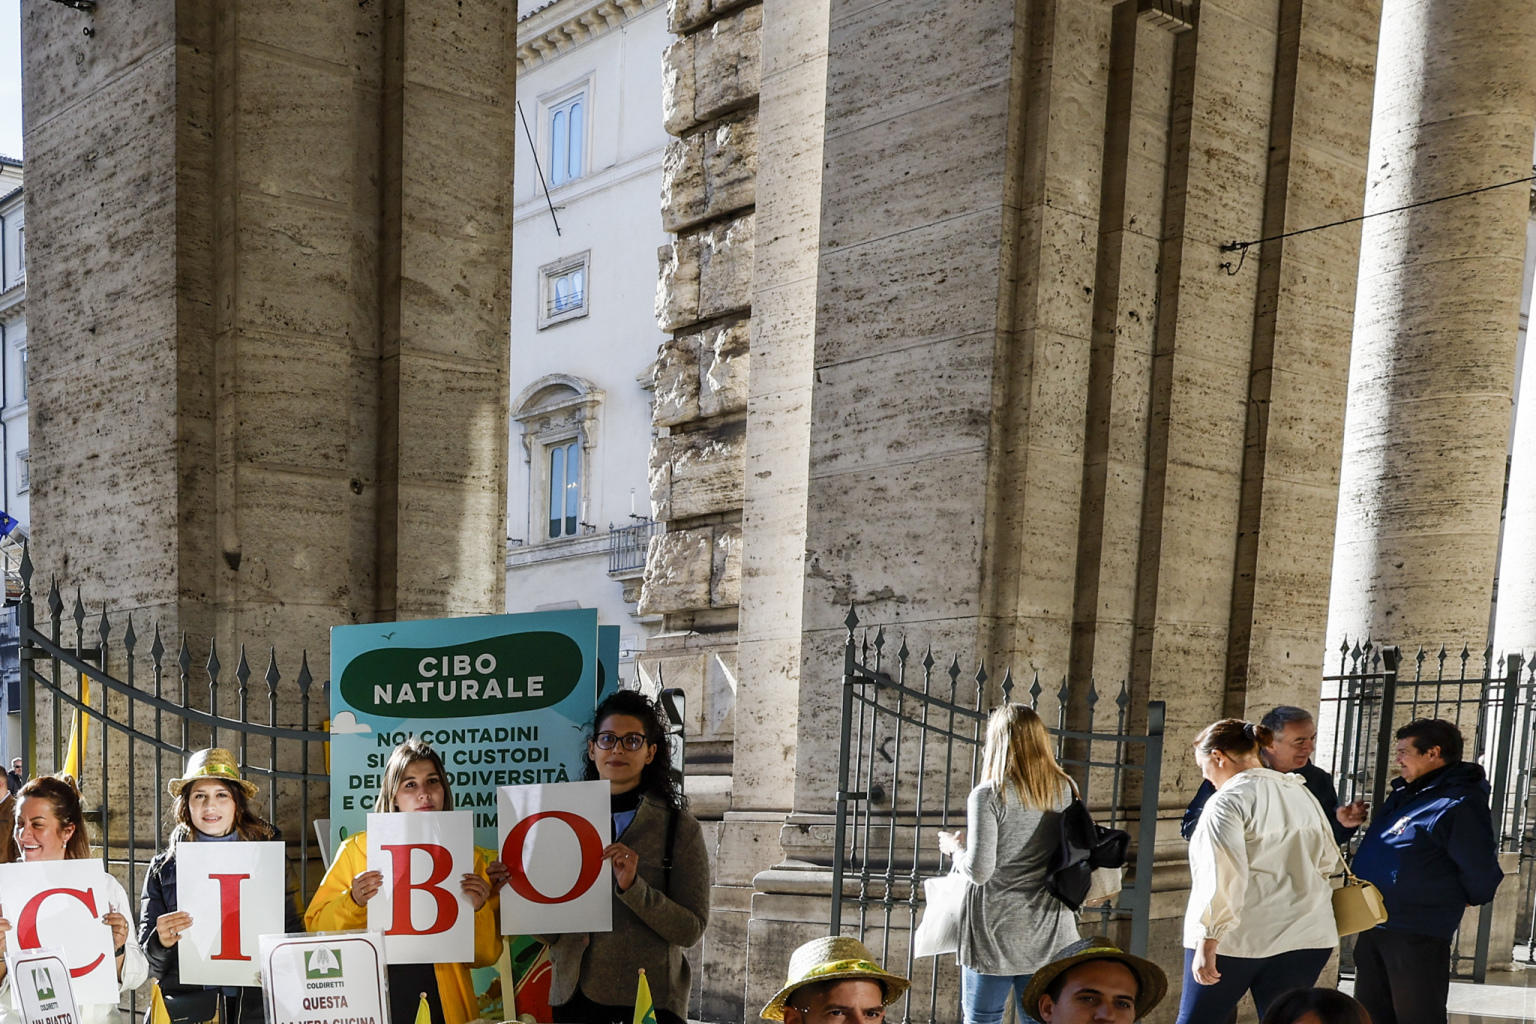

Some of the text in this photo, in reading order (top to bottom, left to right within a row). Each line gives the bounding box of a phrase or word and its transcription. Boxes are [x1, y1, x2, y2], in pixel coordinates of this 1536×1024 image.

[418, 653, 497, 677] CIBO
[374, 676, 544, 704] NATURALE
[420, 726, 538, 745] CONTADINI
[452, 748, 549, 764] CUSTODI
[448, 763, 569, 787] ODIVERSITÀ
[343, 796, 354, 810] E
[307, 981, 344, 989] COLDIRETTI
[303, 995, 348, 1010] QUESTA
